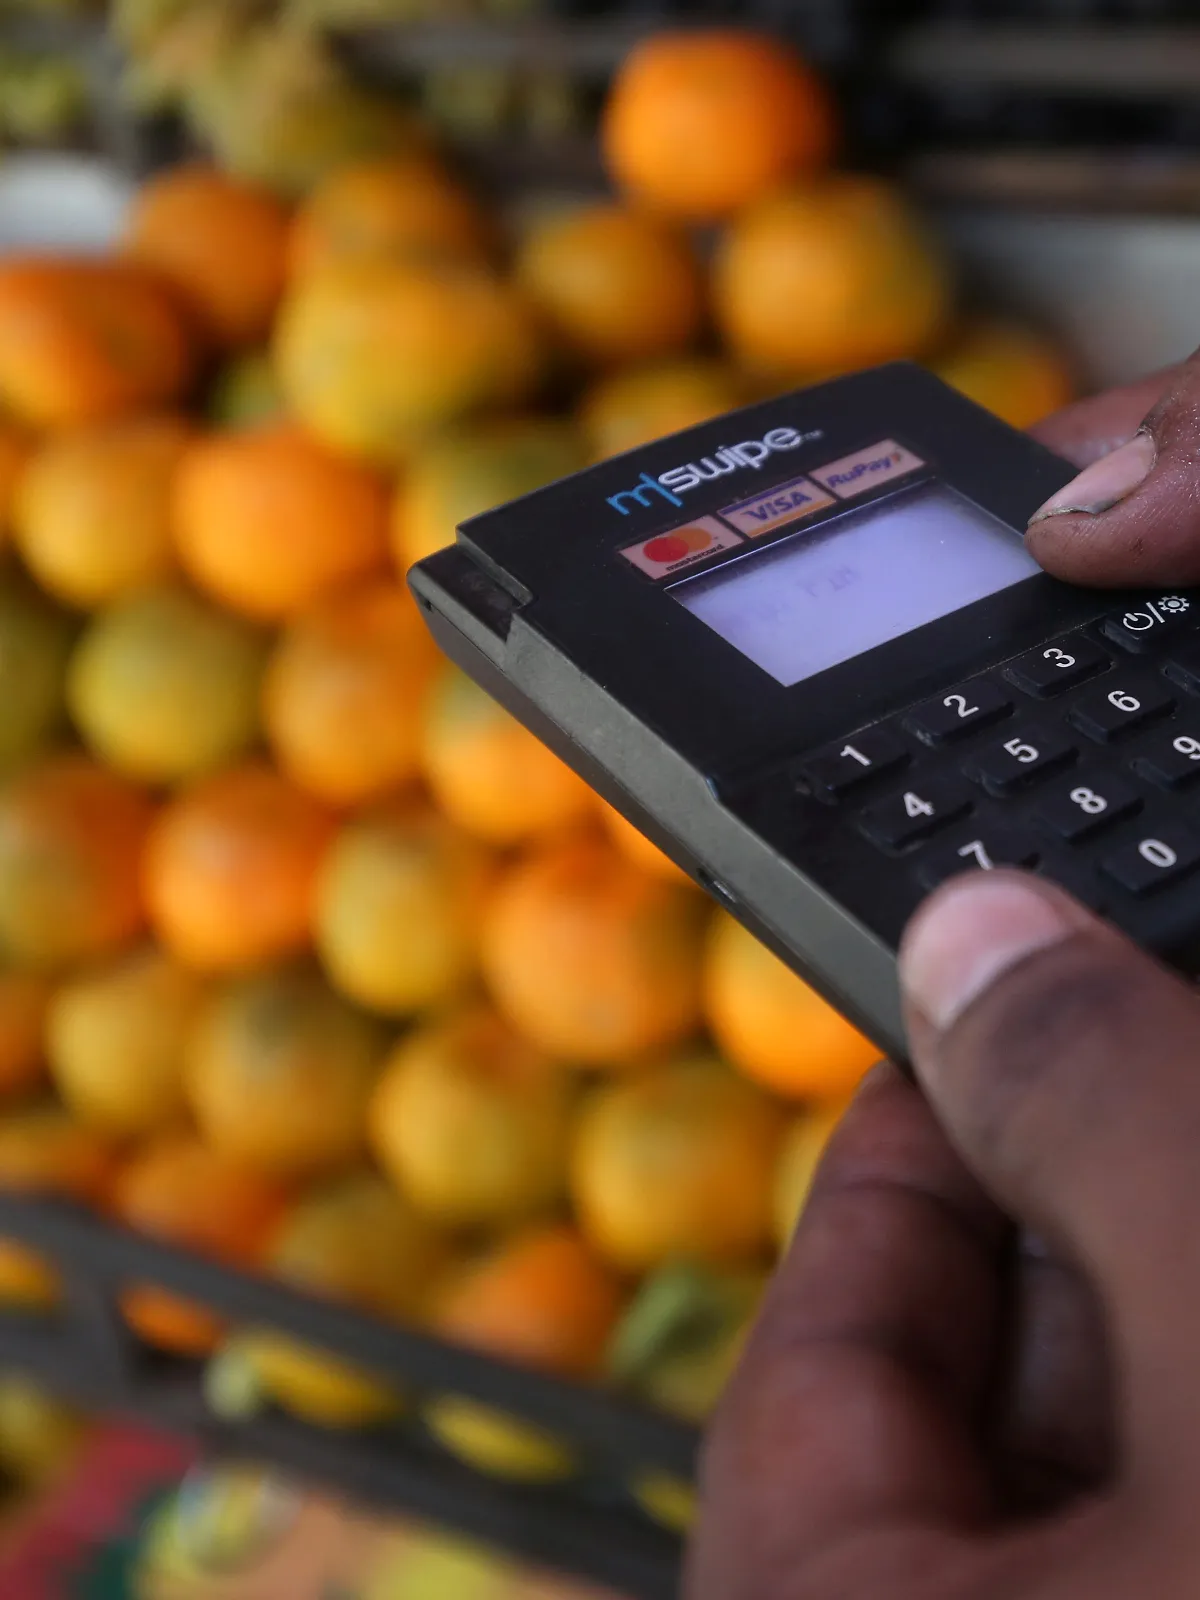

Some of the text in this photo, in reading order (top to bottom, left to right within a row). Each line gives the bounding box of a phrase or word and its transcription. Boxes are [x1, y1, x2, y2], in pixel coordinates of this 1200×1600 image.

[826, 456, 892, 489] RuPay
[743, 490, 813, 523] VISA
[665, 543, 725, 571] mastercard
[839, 647, 1077, 767] 1 2 3
[902, 689, 1142, 818] 4 5 6
[957, 840, 994, 872] 7
[1069, 786, 1108, 815] 8
[1138, 838, 1177, 868] 0
